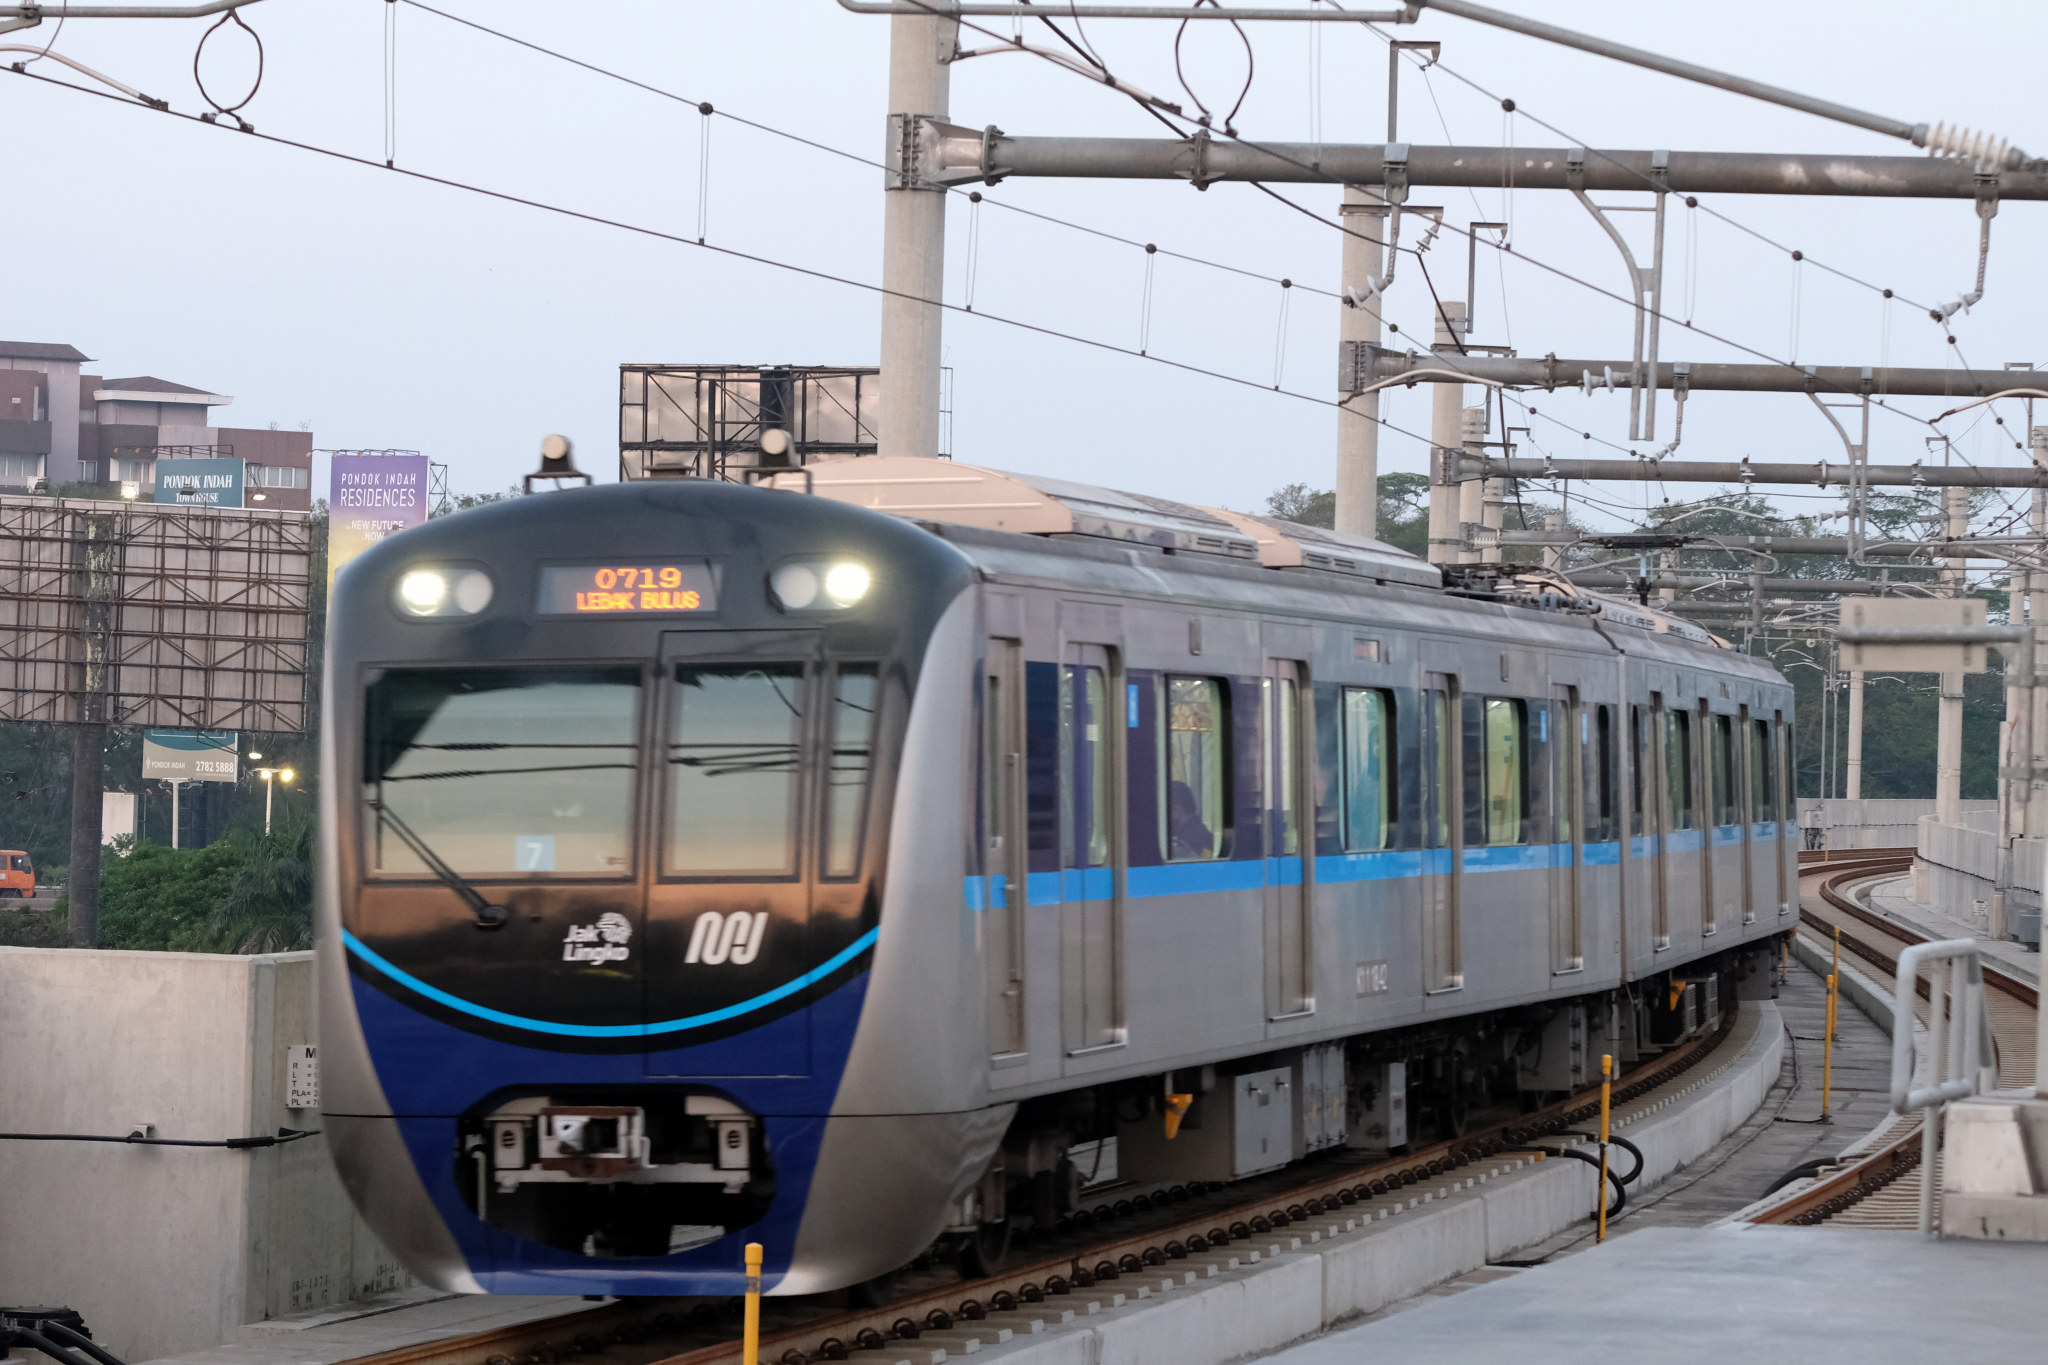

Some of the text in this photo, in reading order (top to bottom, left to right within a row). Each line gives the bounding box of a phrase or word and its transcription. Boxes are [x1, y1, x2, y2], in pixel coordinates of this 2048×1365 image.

[163, 474, 233, 489] PONDOK INDAH
[341, 473, 416, 485] PONDOK INDAH
[340, 488, 416, 507] RESIDENCES
[351, 520, 370, 530] NEW
[364, 531, 385, 541] NOW
[594, 567, 682, 590] 0719
[576, 590, 700, 610] LEBAK BULUS
[195, 761, 214, 772] 2782
[215, 761, 234, 773] 5888
[527, 842, 543, 869] 7
[562, 943, 630, 965] Lingko
[291, 1098, 301, 1106] PL
